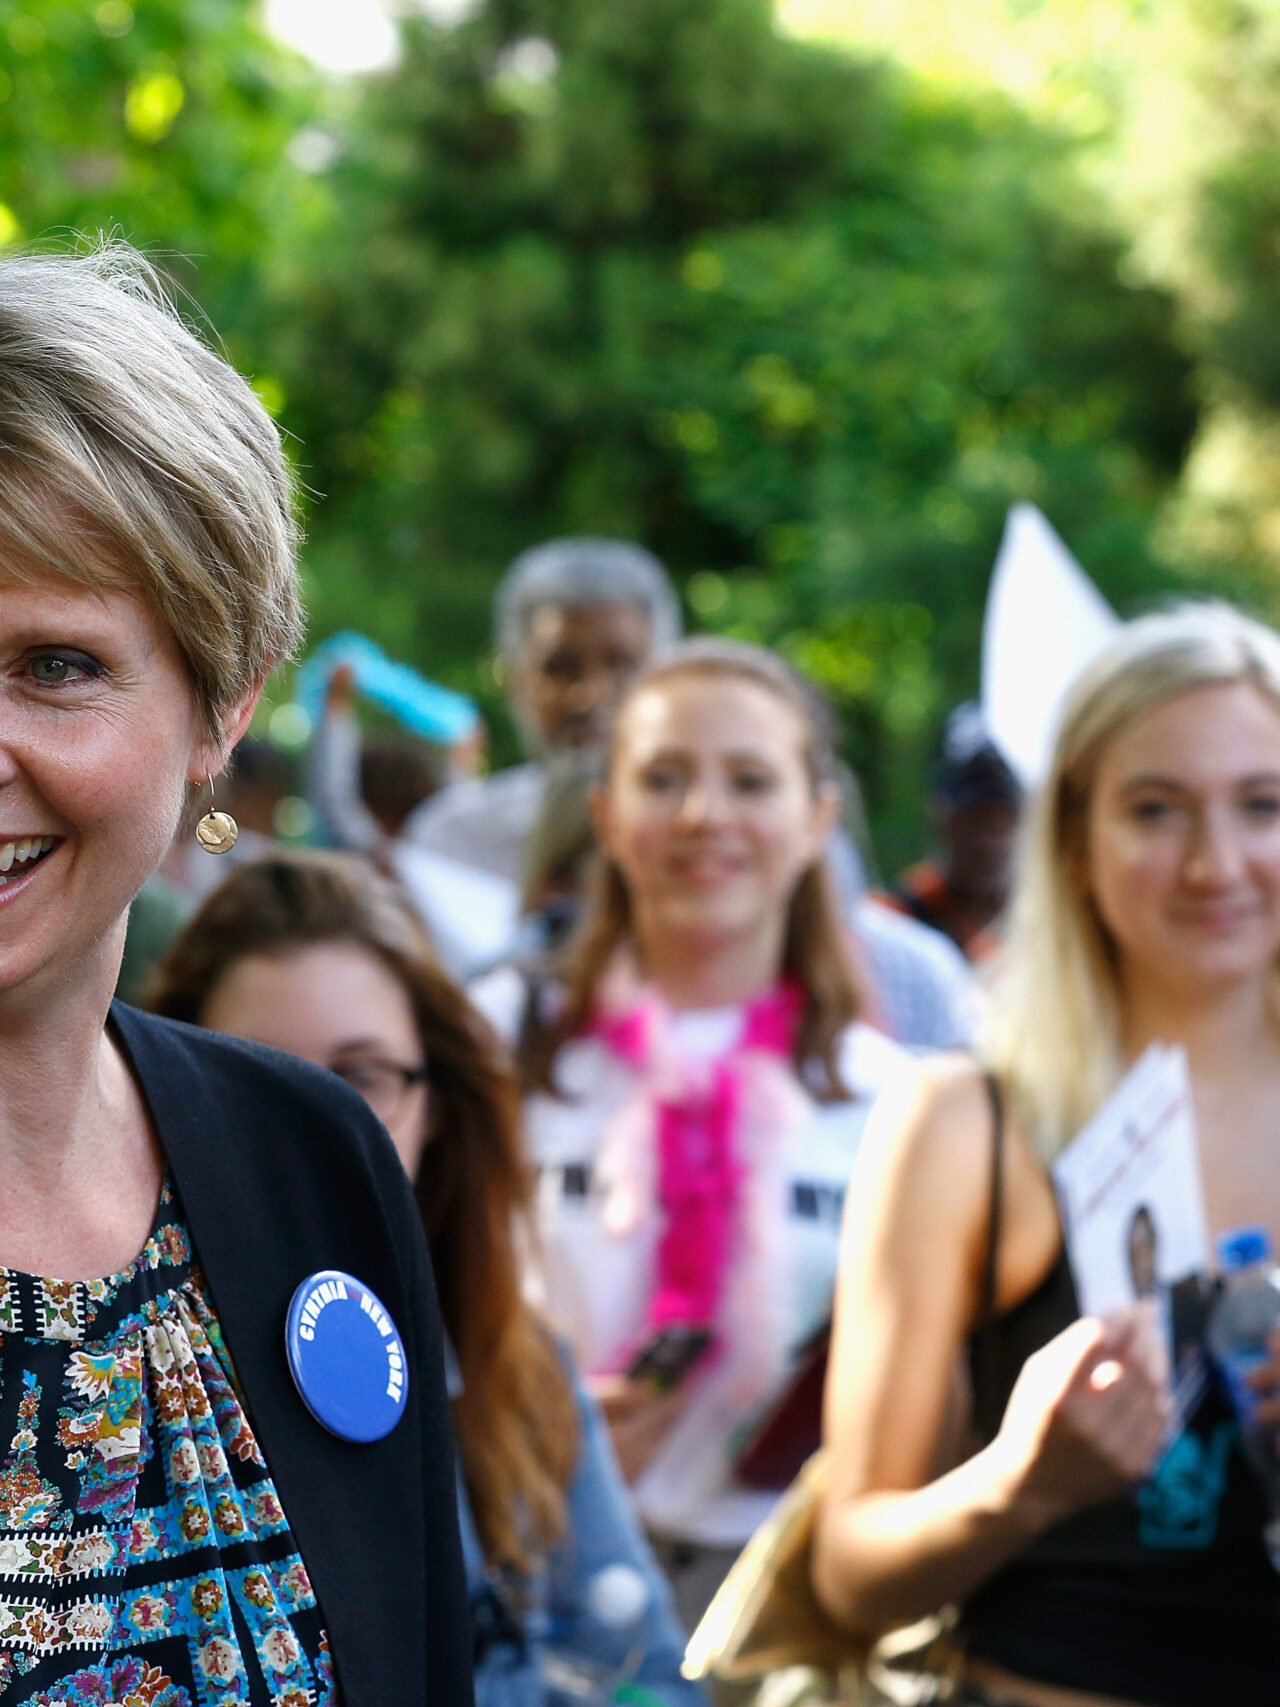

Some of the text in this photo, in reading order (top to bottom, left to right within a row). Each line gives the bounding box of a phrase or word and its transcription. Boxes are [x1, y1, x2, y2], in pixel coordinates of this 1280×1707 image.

[299, 1280, 404, 1403] CYNTHIA NEW YORK
